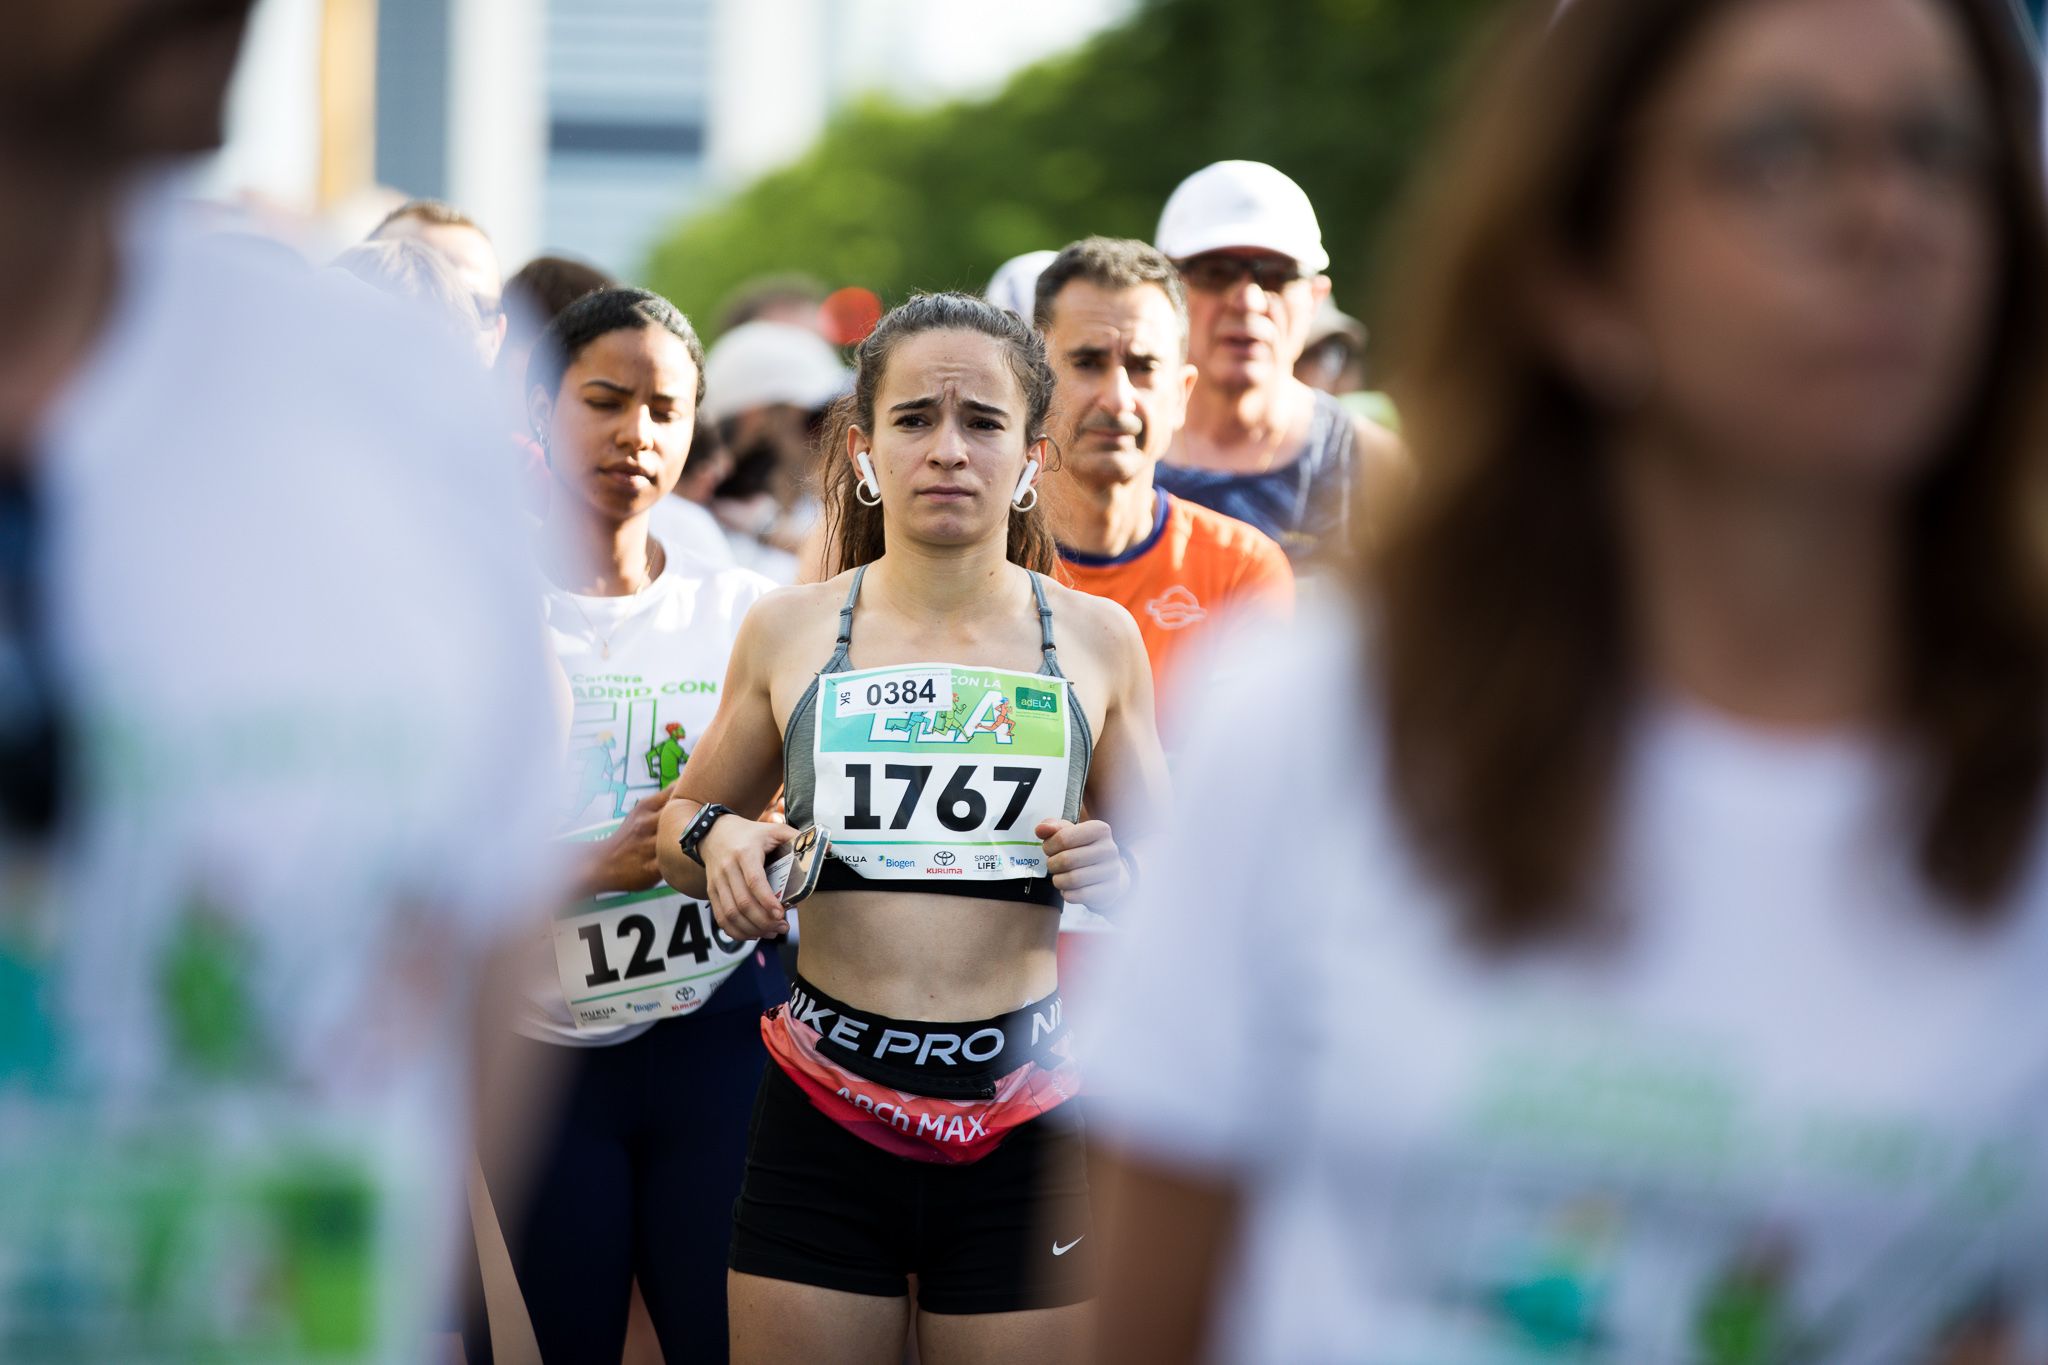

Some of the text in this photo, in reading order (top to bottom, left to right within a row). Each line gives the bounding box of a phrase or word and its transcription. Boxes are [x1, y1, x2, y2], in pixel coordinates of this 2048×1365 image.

[573, 681, 718, 699] ADRID CON
[866, 678, 937, 706] 0384
[984, 678, 1001, 689] LA
[840, 691, 851, 706] 5K
[844, 763, 1042, 832] 1767
[886, 858, 915, 869] Biogen
[977, 862, 996, 870] LIFE
[872, 1027, 1005, 1065] PRO
[916, 1111, 988, 1143] MAX
